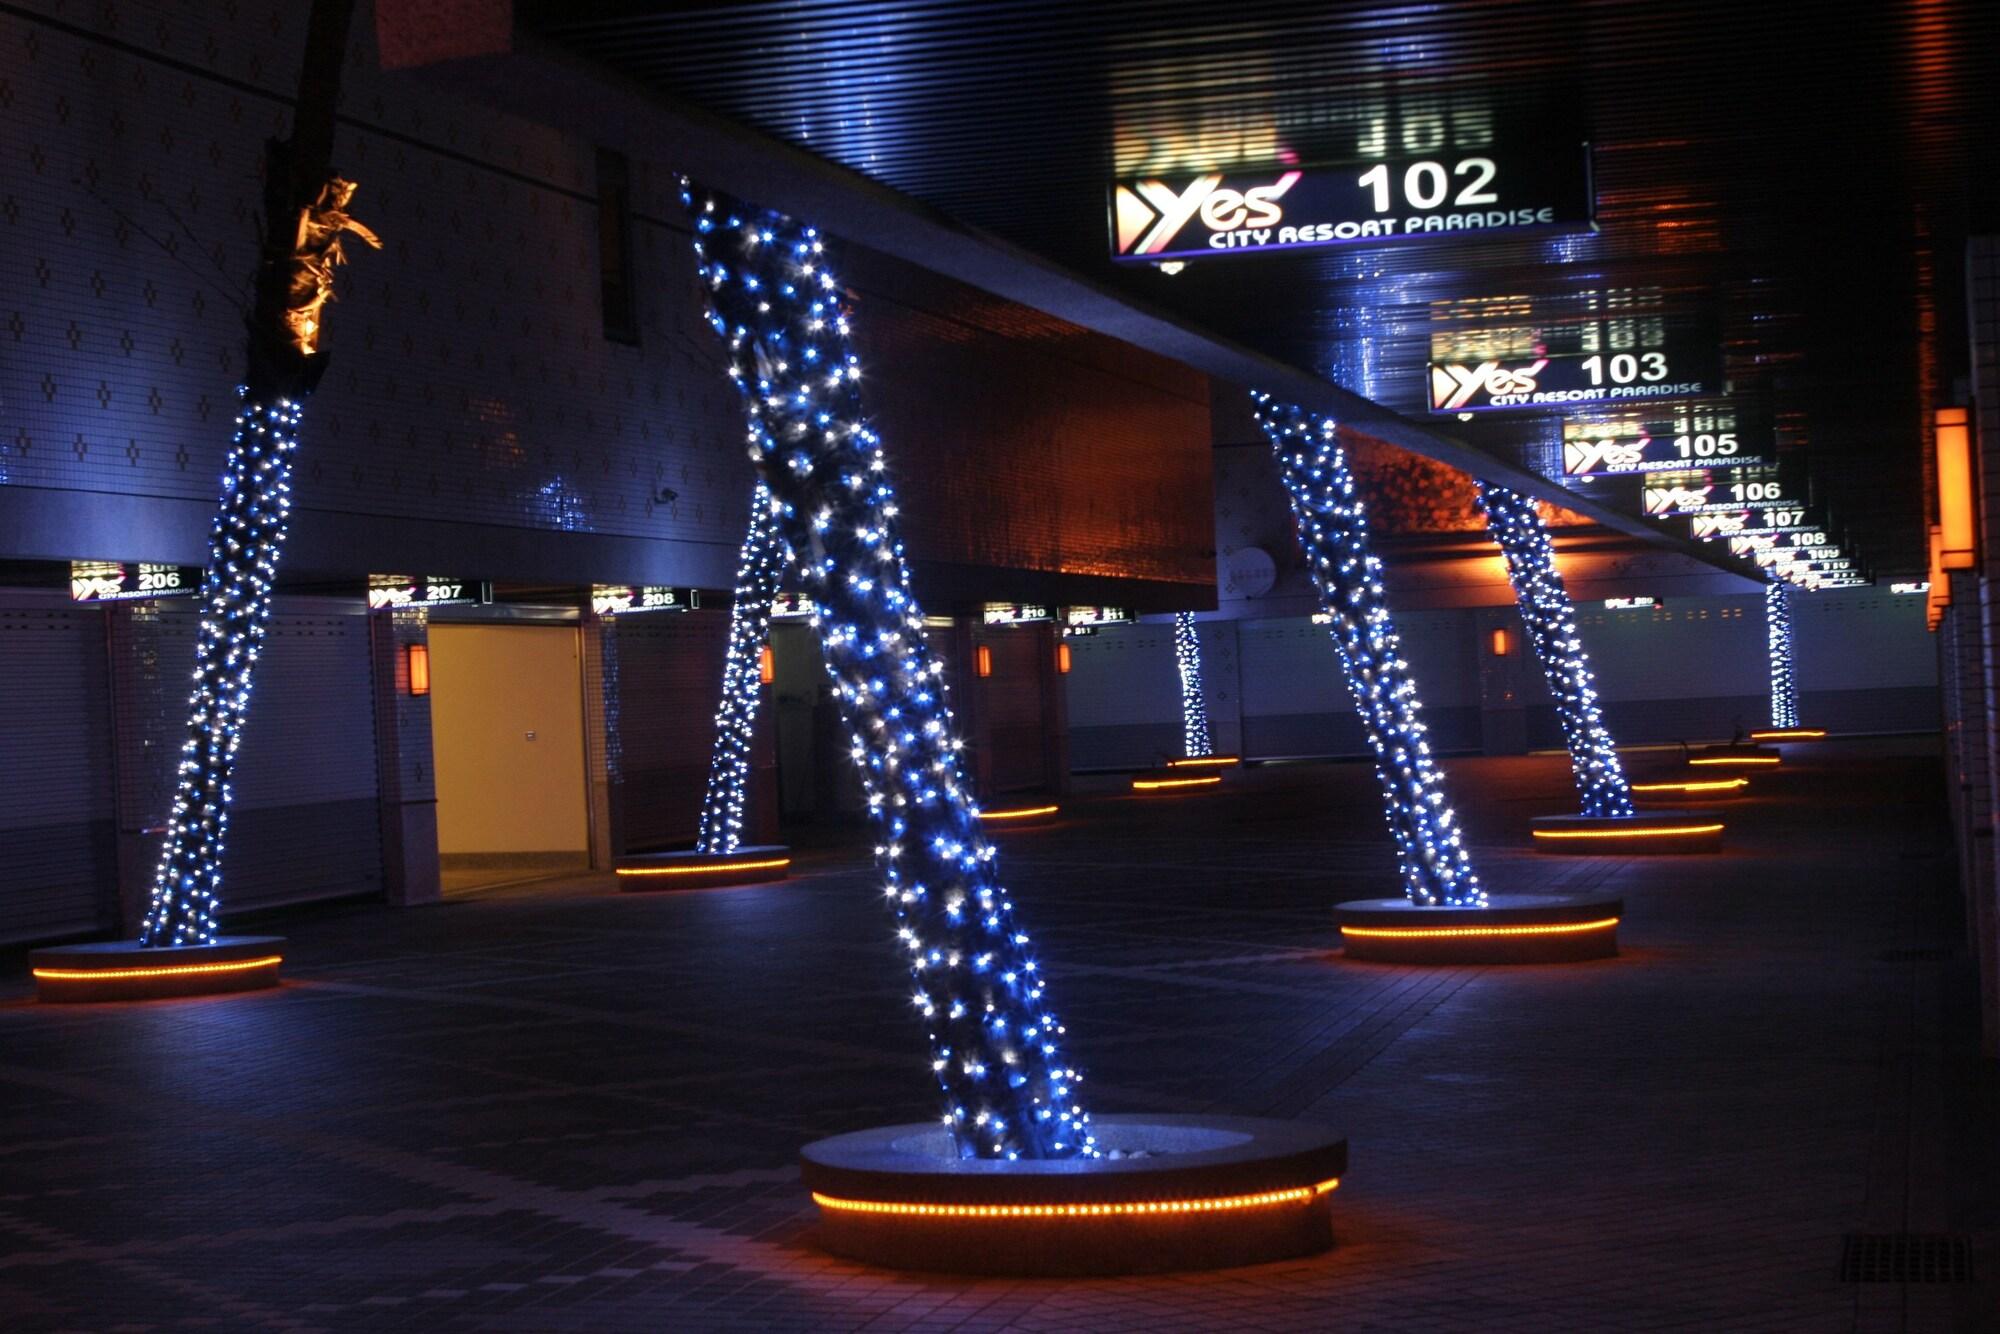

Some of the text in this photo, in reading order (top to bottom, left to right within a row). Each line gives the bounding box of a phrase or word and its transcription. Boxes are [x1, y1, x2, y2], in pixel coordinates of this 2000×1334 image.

[1358, 157, 1498, 213] 102
[1134, 171, 1302, 255] Yes
[1209, 207, 1553, 249] CITY RESORT PARADISE
[1581, 352, 1668, 386] 103
[1489, 382, 1702, 406] CITY RESORT PARADISE
[1673, 433, 1738, 458] 105
[1606, 455, 1762, 472] CITY RESORT PARADISE
[1730, 482, 1781, 501] 106
[1763, 511, 1805, 527] 107
[1790, 532, 1826, 546] 108
[139, 573, 180, 590] 206
[427, 585, 462, 600] 207
[643, 593, 674, 606] 208
